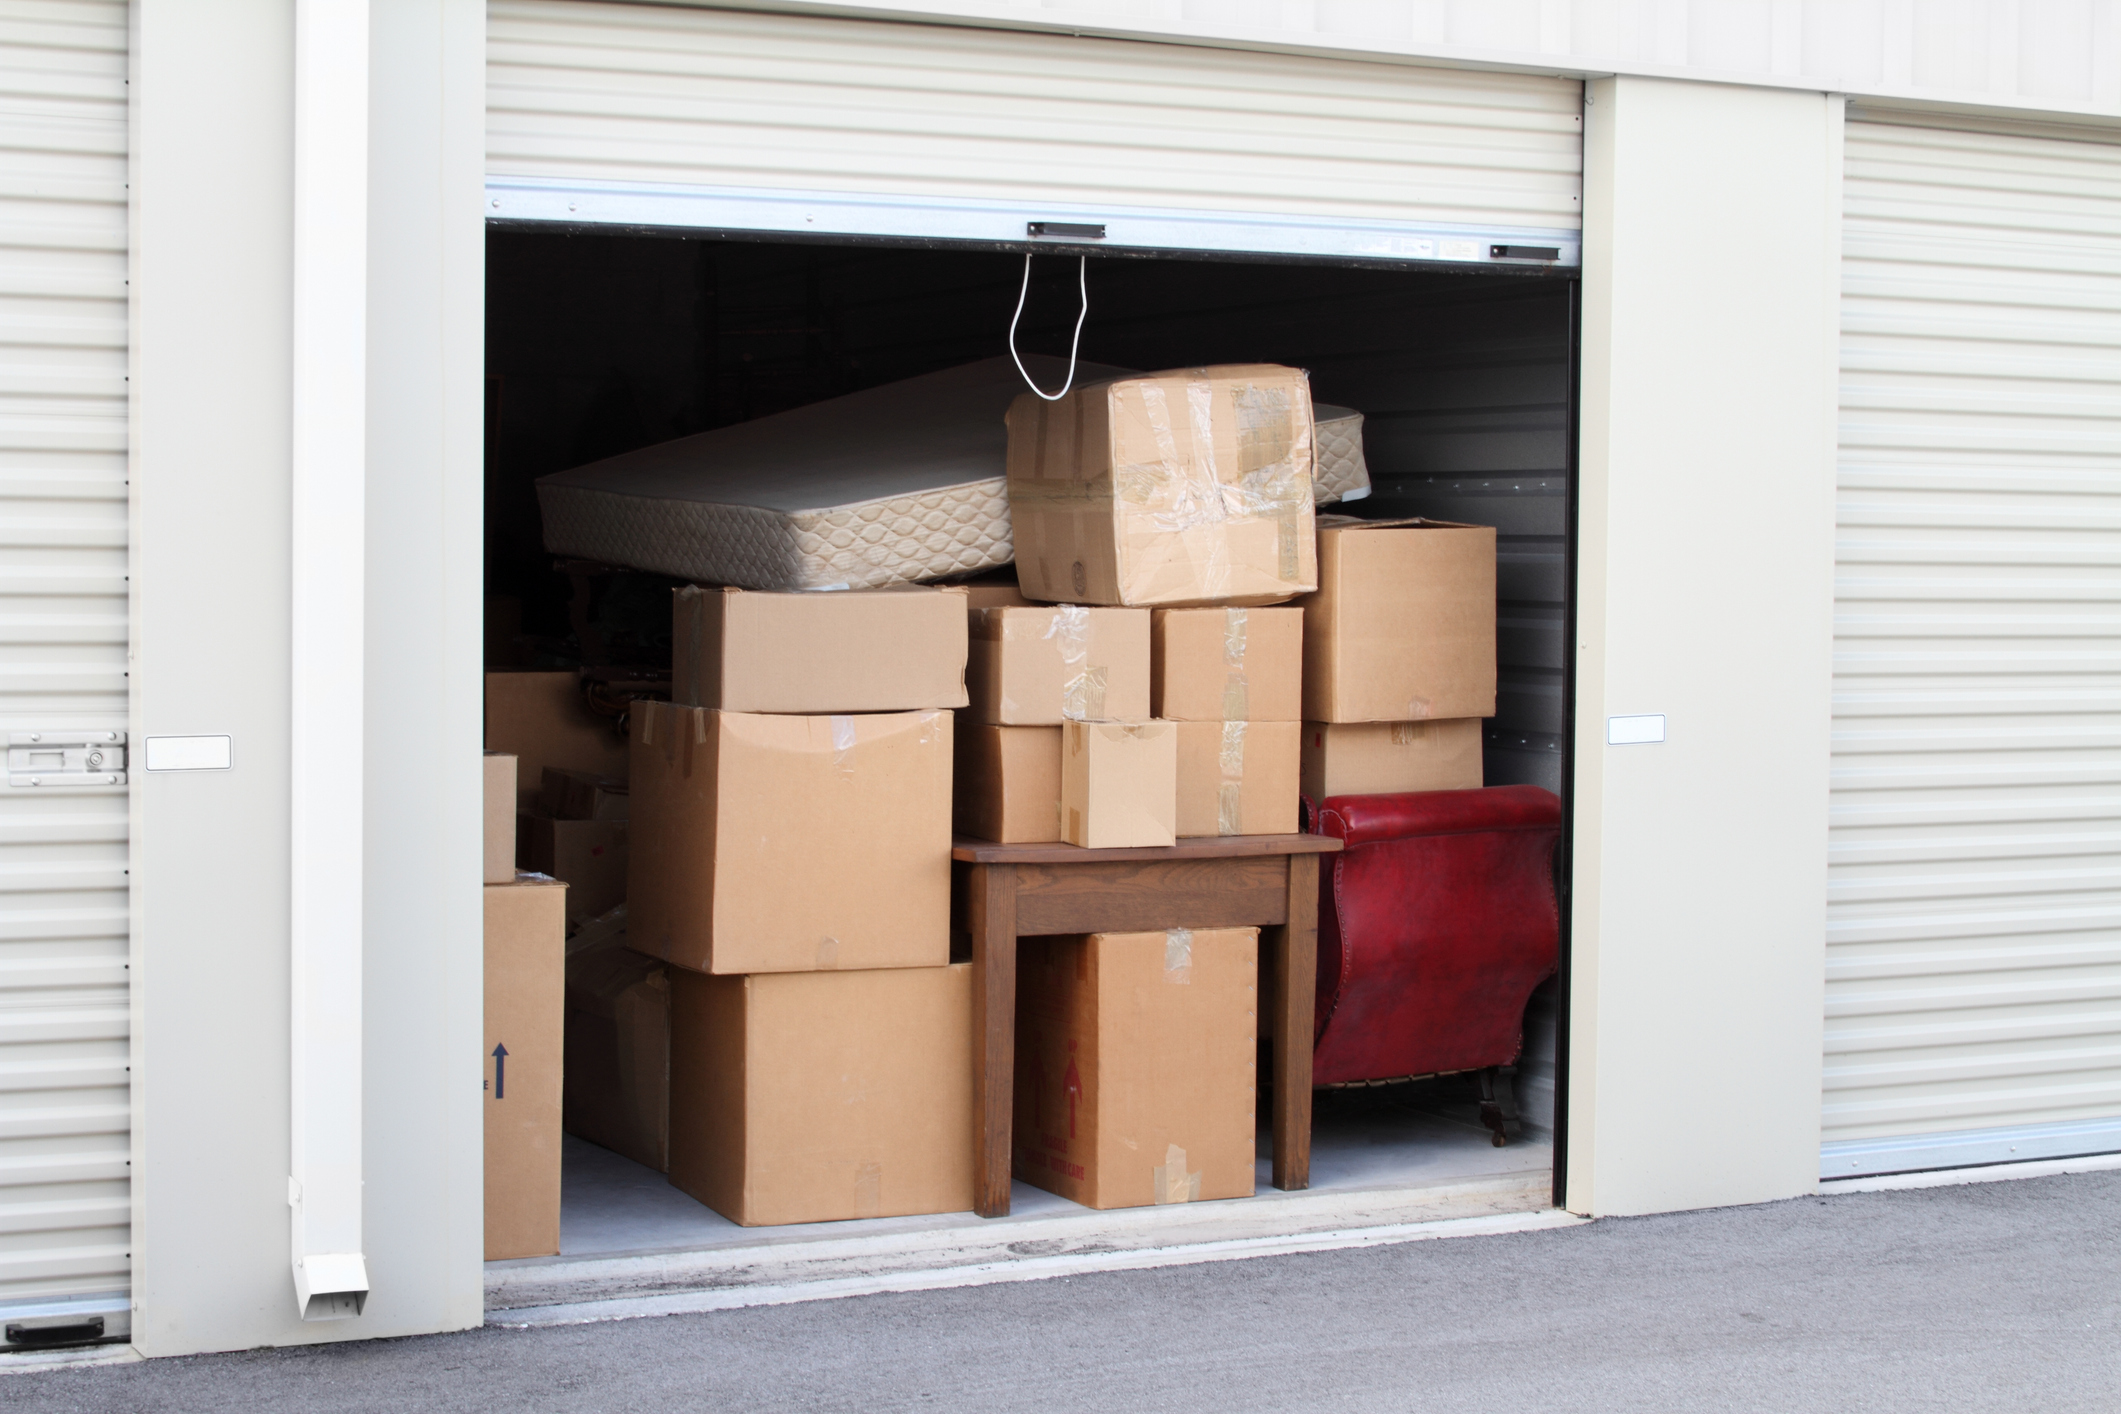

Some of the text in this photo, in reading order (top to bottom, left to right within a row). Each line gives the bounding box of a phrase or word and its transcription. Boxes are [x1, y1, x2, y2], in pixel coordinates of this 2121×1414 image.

[1068, 1038, 1078, 1053] UP
[1040, 1132, 1067, 1154] FRAGILE
[1050, 1155, 1067, 1175] WITH
[1067, 1162, 1085, 1181] CARE
